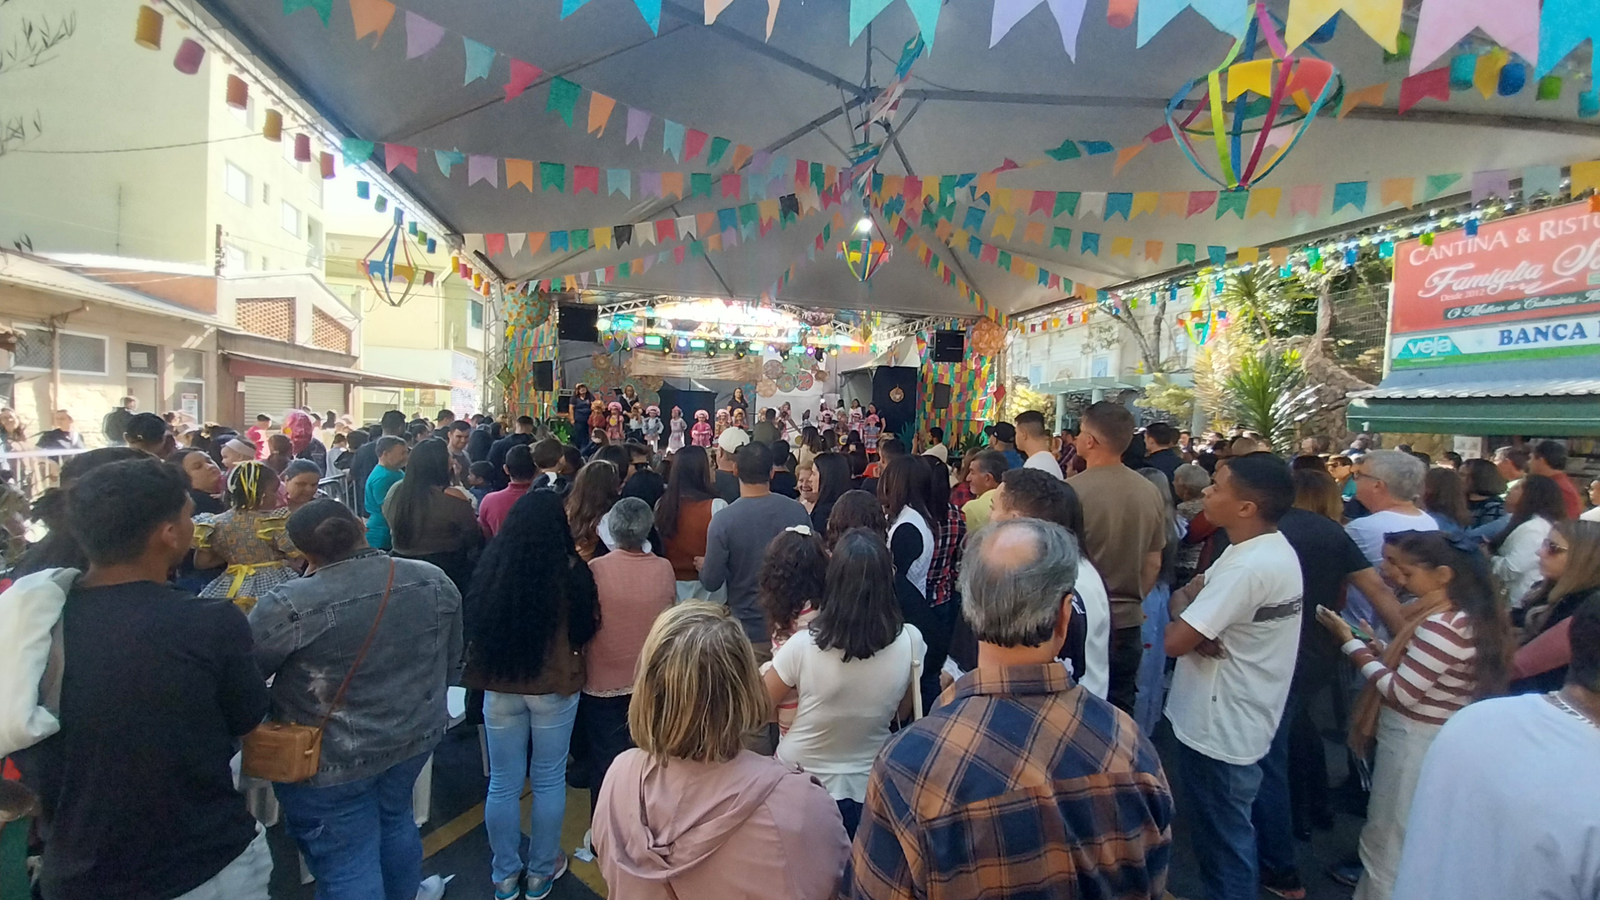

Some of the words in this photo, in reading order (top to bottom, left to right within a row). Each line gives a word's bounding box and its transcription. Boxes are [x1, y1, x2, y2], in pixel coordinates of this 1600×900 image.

[1409, 230, 1508, 266] CANTINA
[1516, 228, 1531, 244] &
[1418, 260, 1545, 298] Famiglia
[1464, 289, 1486, 299] 2012
[1498, 321, 1588, 346] BANCA
[1407, 336, 1452, 357] veja
